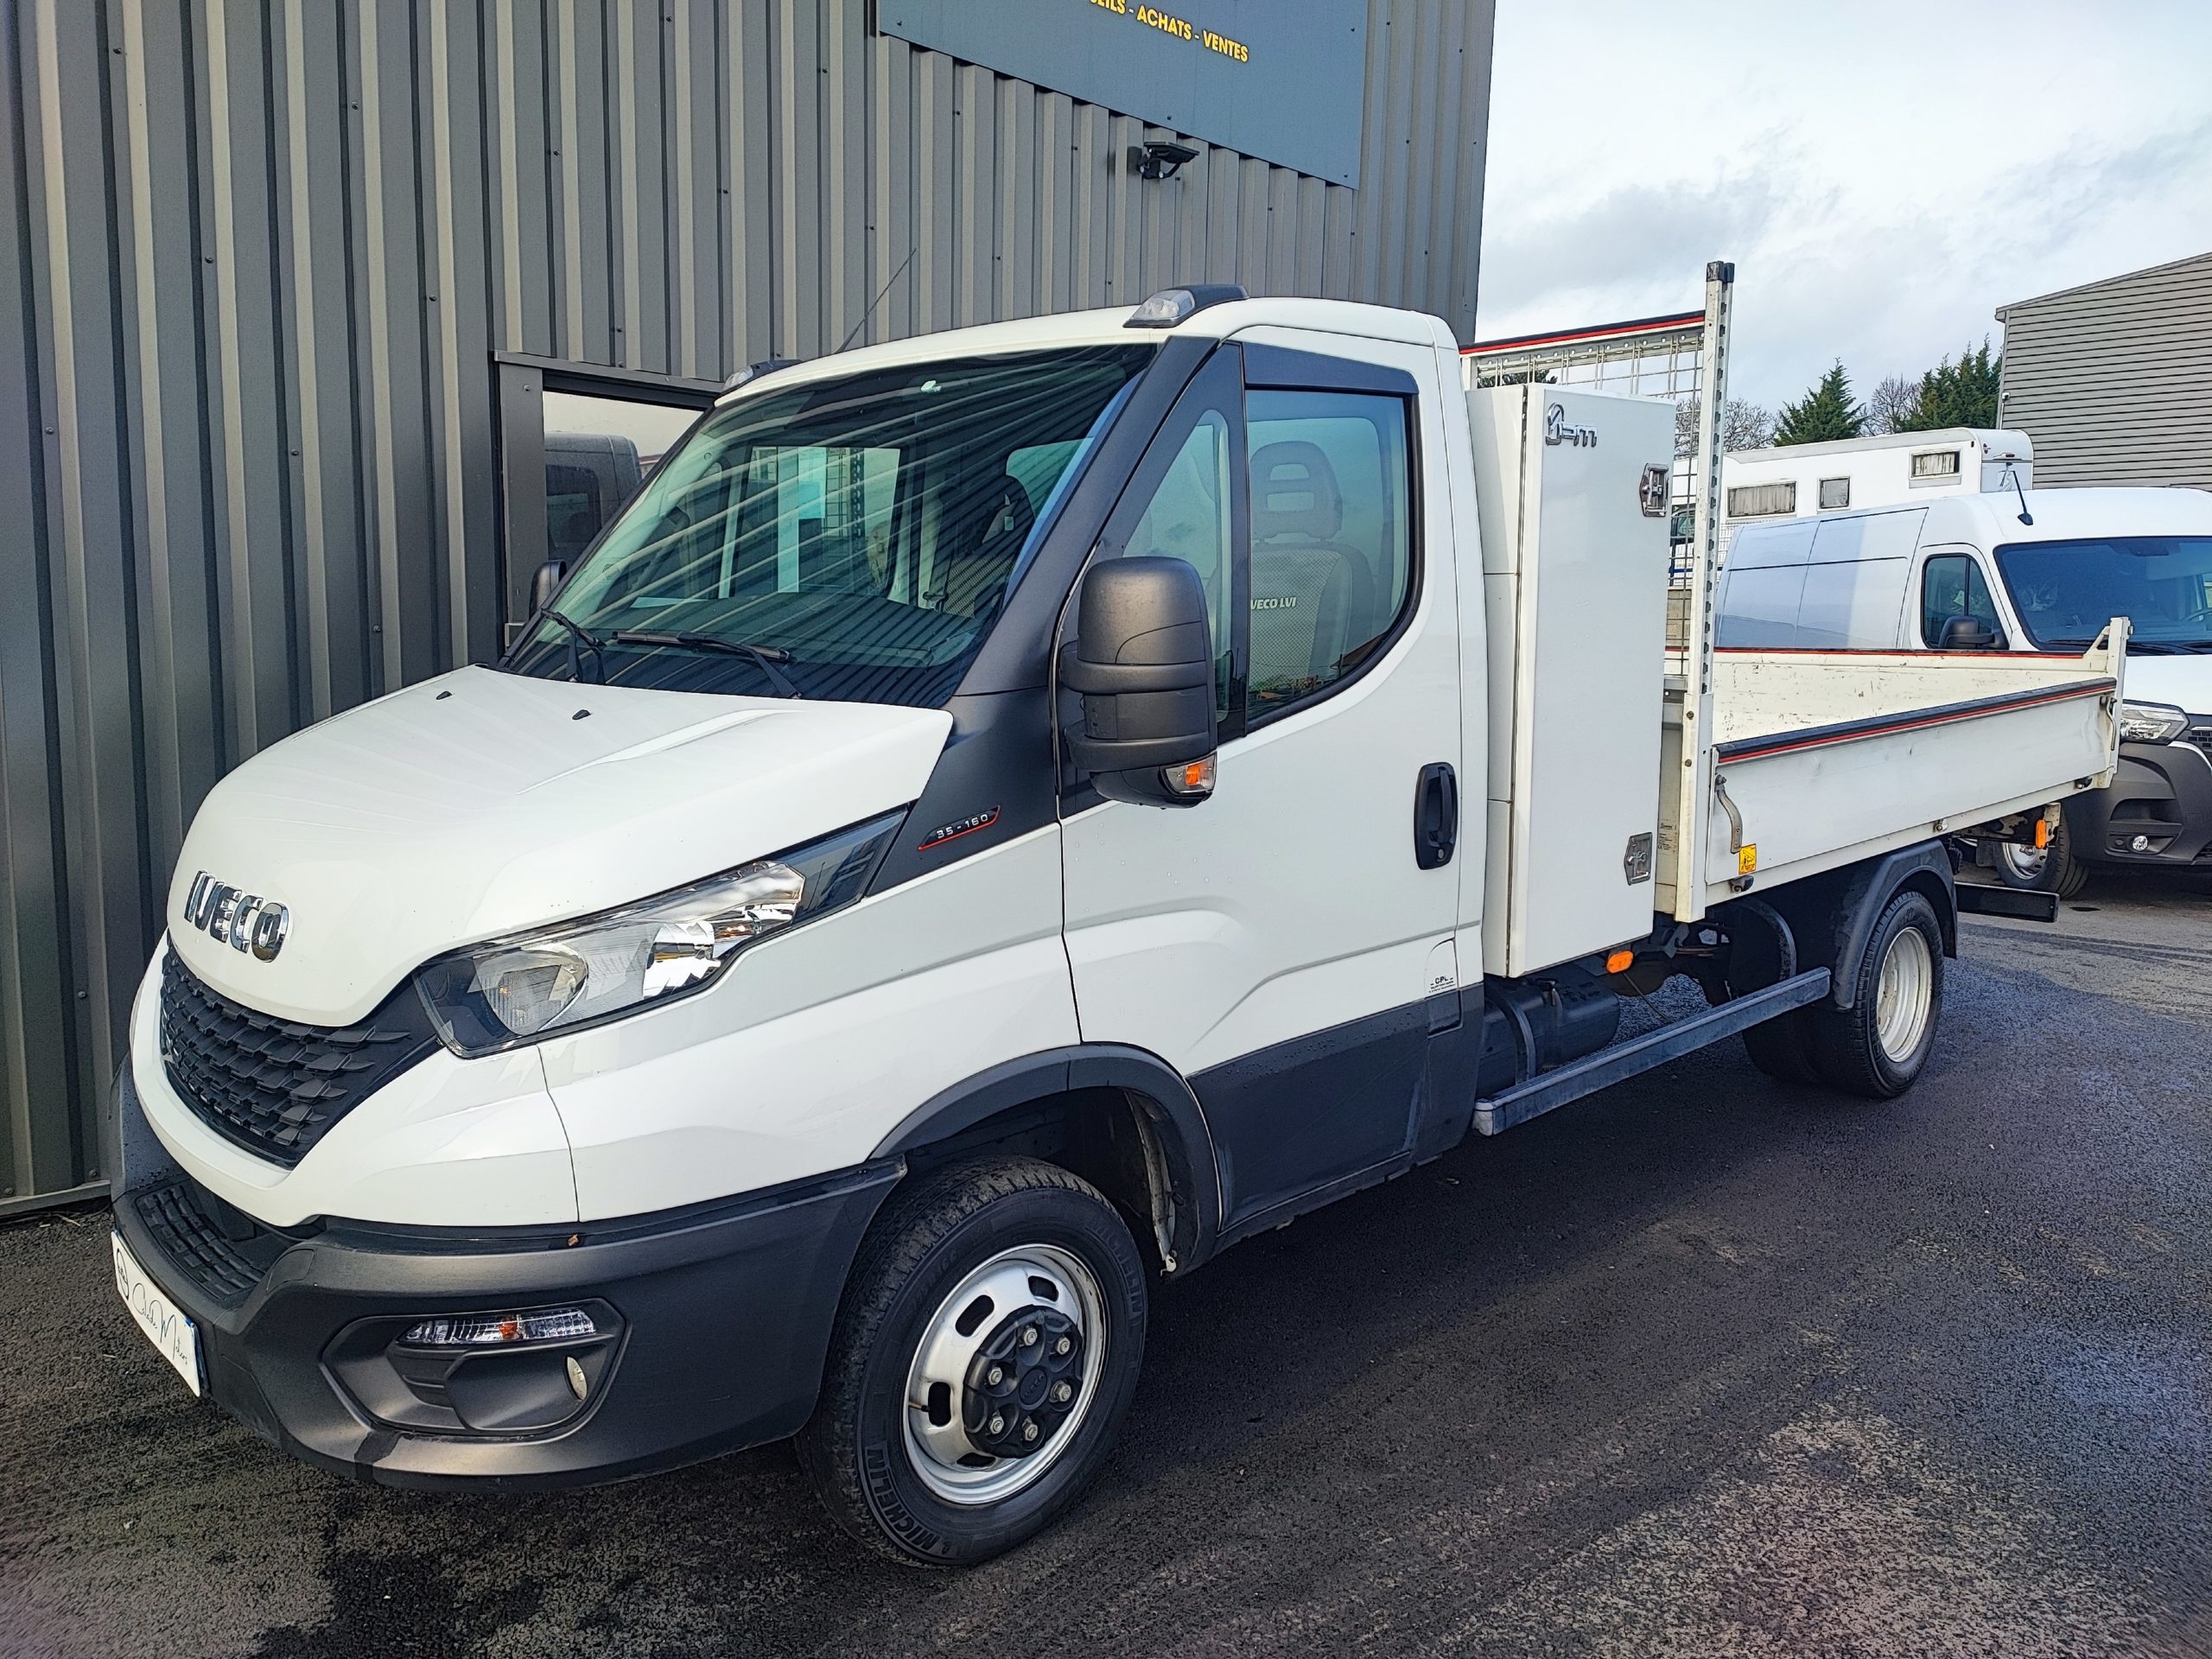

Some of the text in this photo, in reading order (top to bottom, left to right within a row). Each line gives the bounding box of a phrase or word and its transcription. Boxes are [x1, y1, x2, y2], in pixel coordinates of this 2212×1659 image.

[1136, 4, 1192, 41] ACHATS
[1202, 29, 1249, 63] VENTES
[1250, 596, 1296, 610] VECO LVI
[183, 869, 289, 963] IVECO
[865, 1447, 941, 1552] MICHELIN
